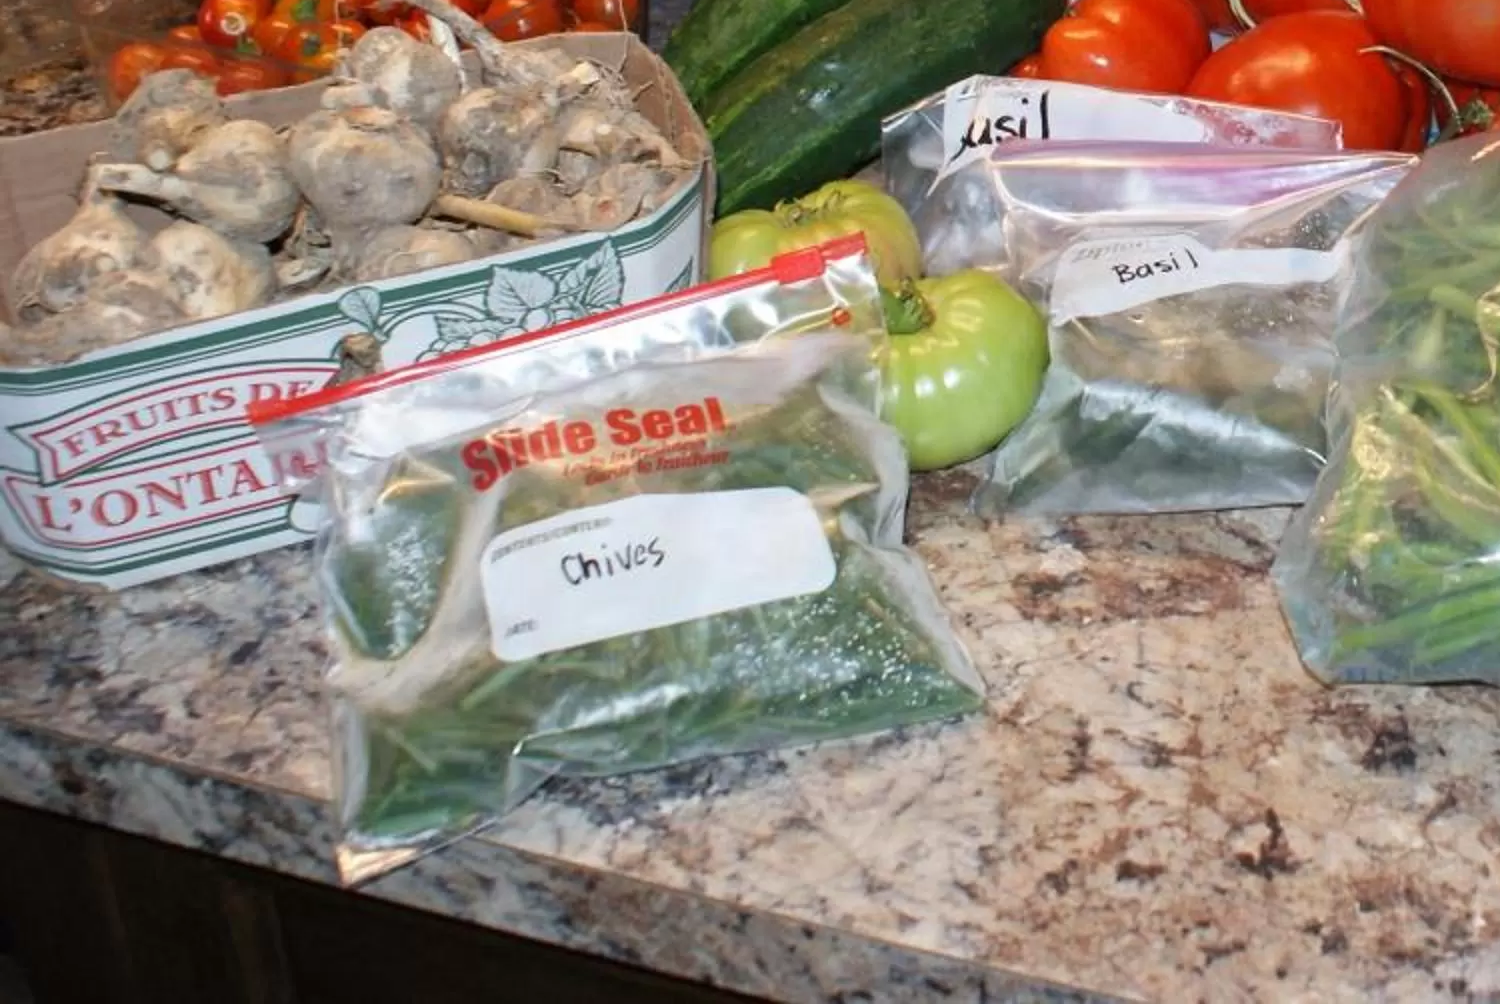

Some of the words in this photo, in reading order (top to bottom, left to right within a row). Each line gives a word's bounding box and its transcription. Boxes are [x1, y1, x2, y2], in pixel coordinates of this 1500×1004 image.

[1112, 246, 1198, 284] Basil
[60, 387, 237, 458] FRUITS
[460, 418, 597, 492] Slide
[605, 396, 726, 446] Seal
[561, 535, 665, 585] Chives
